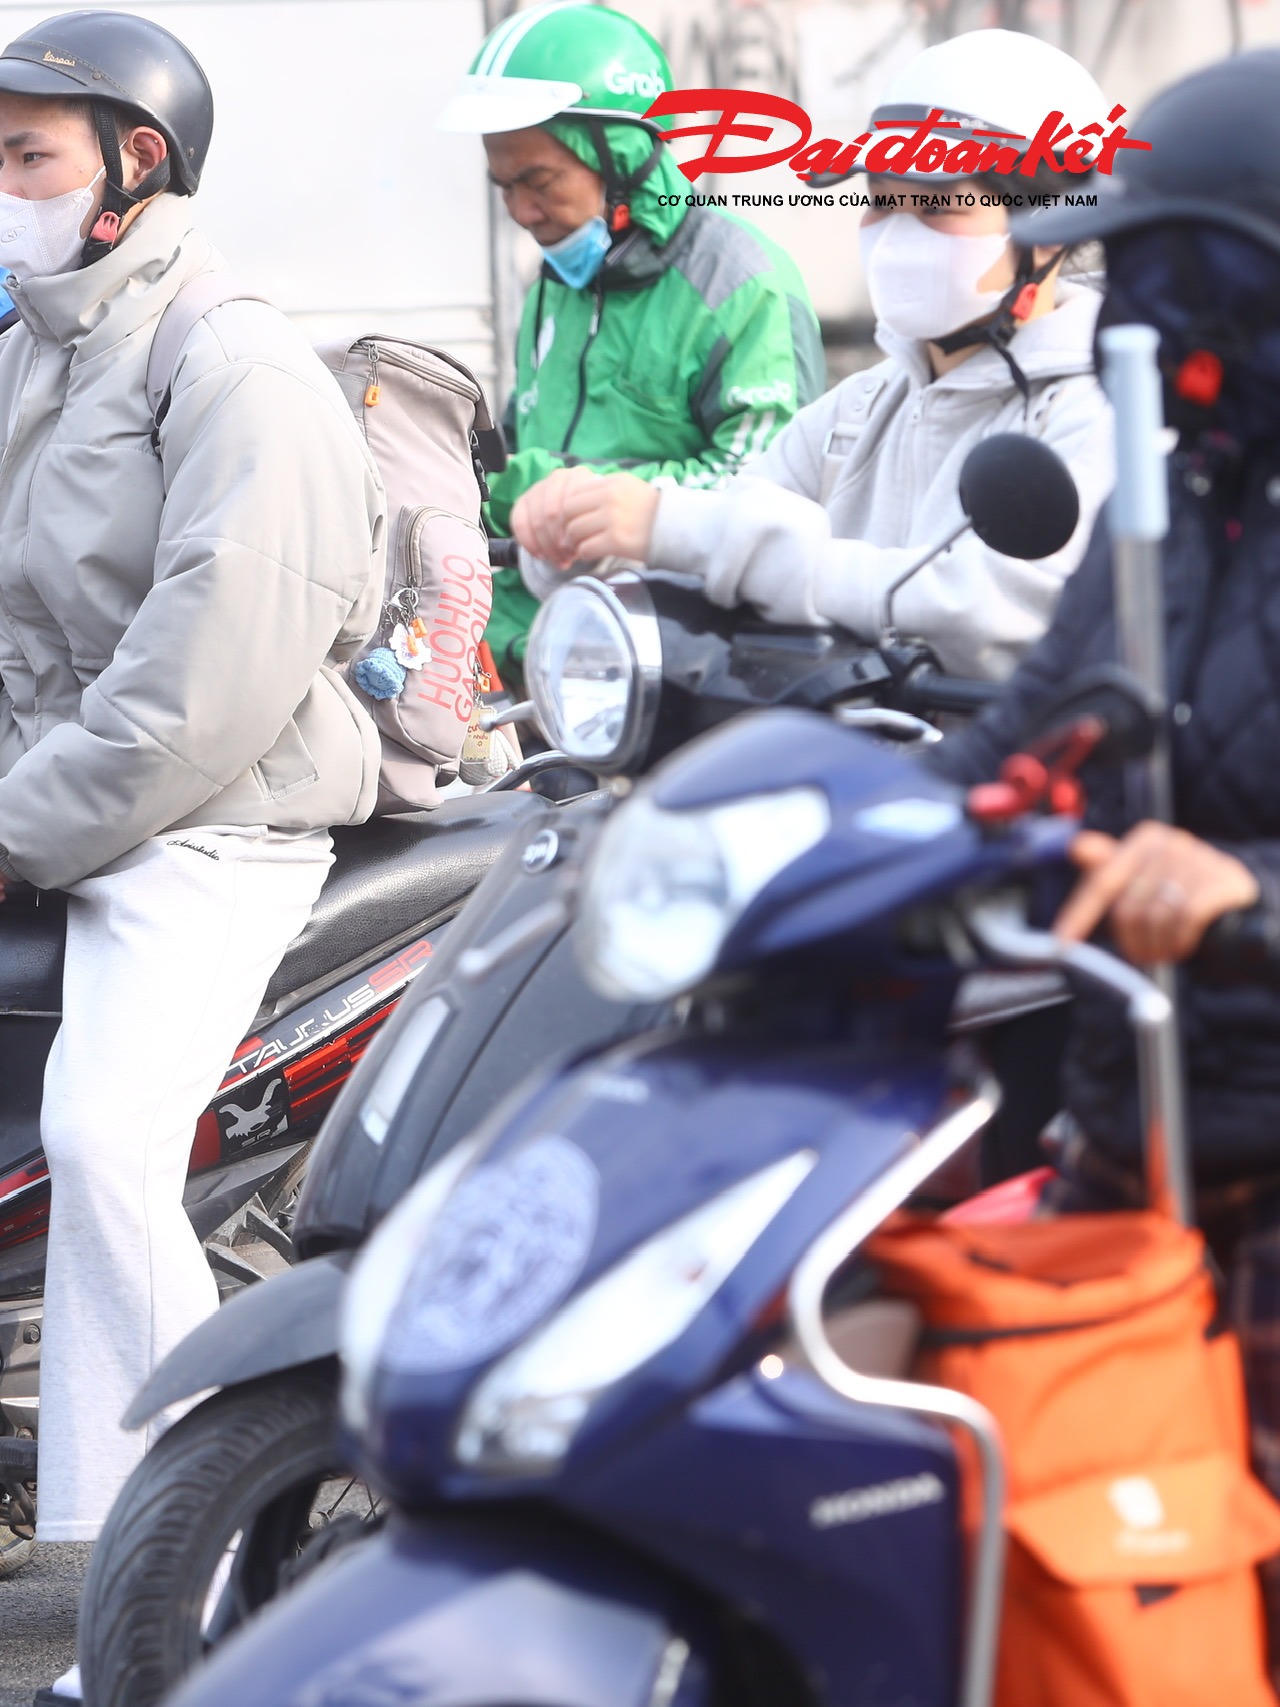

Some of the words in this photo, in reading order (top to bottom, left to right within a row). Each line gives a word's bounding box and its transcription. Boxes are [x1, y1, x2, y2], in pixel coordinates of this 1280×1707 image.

[604, 60, 666, 100] Grab
[417, 554, 475, 709] HUOHUO
[225, 984, 377, 1074] TAURUS
[369, 940, 433, 992] SR
